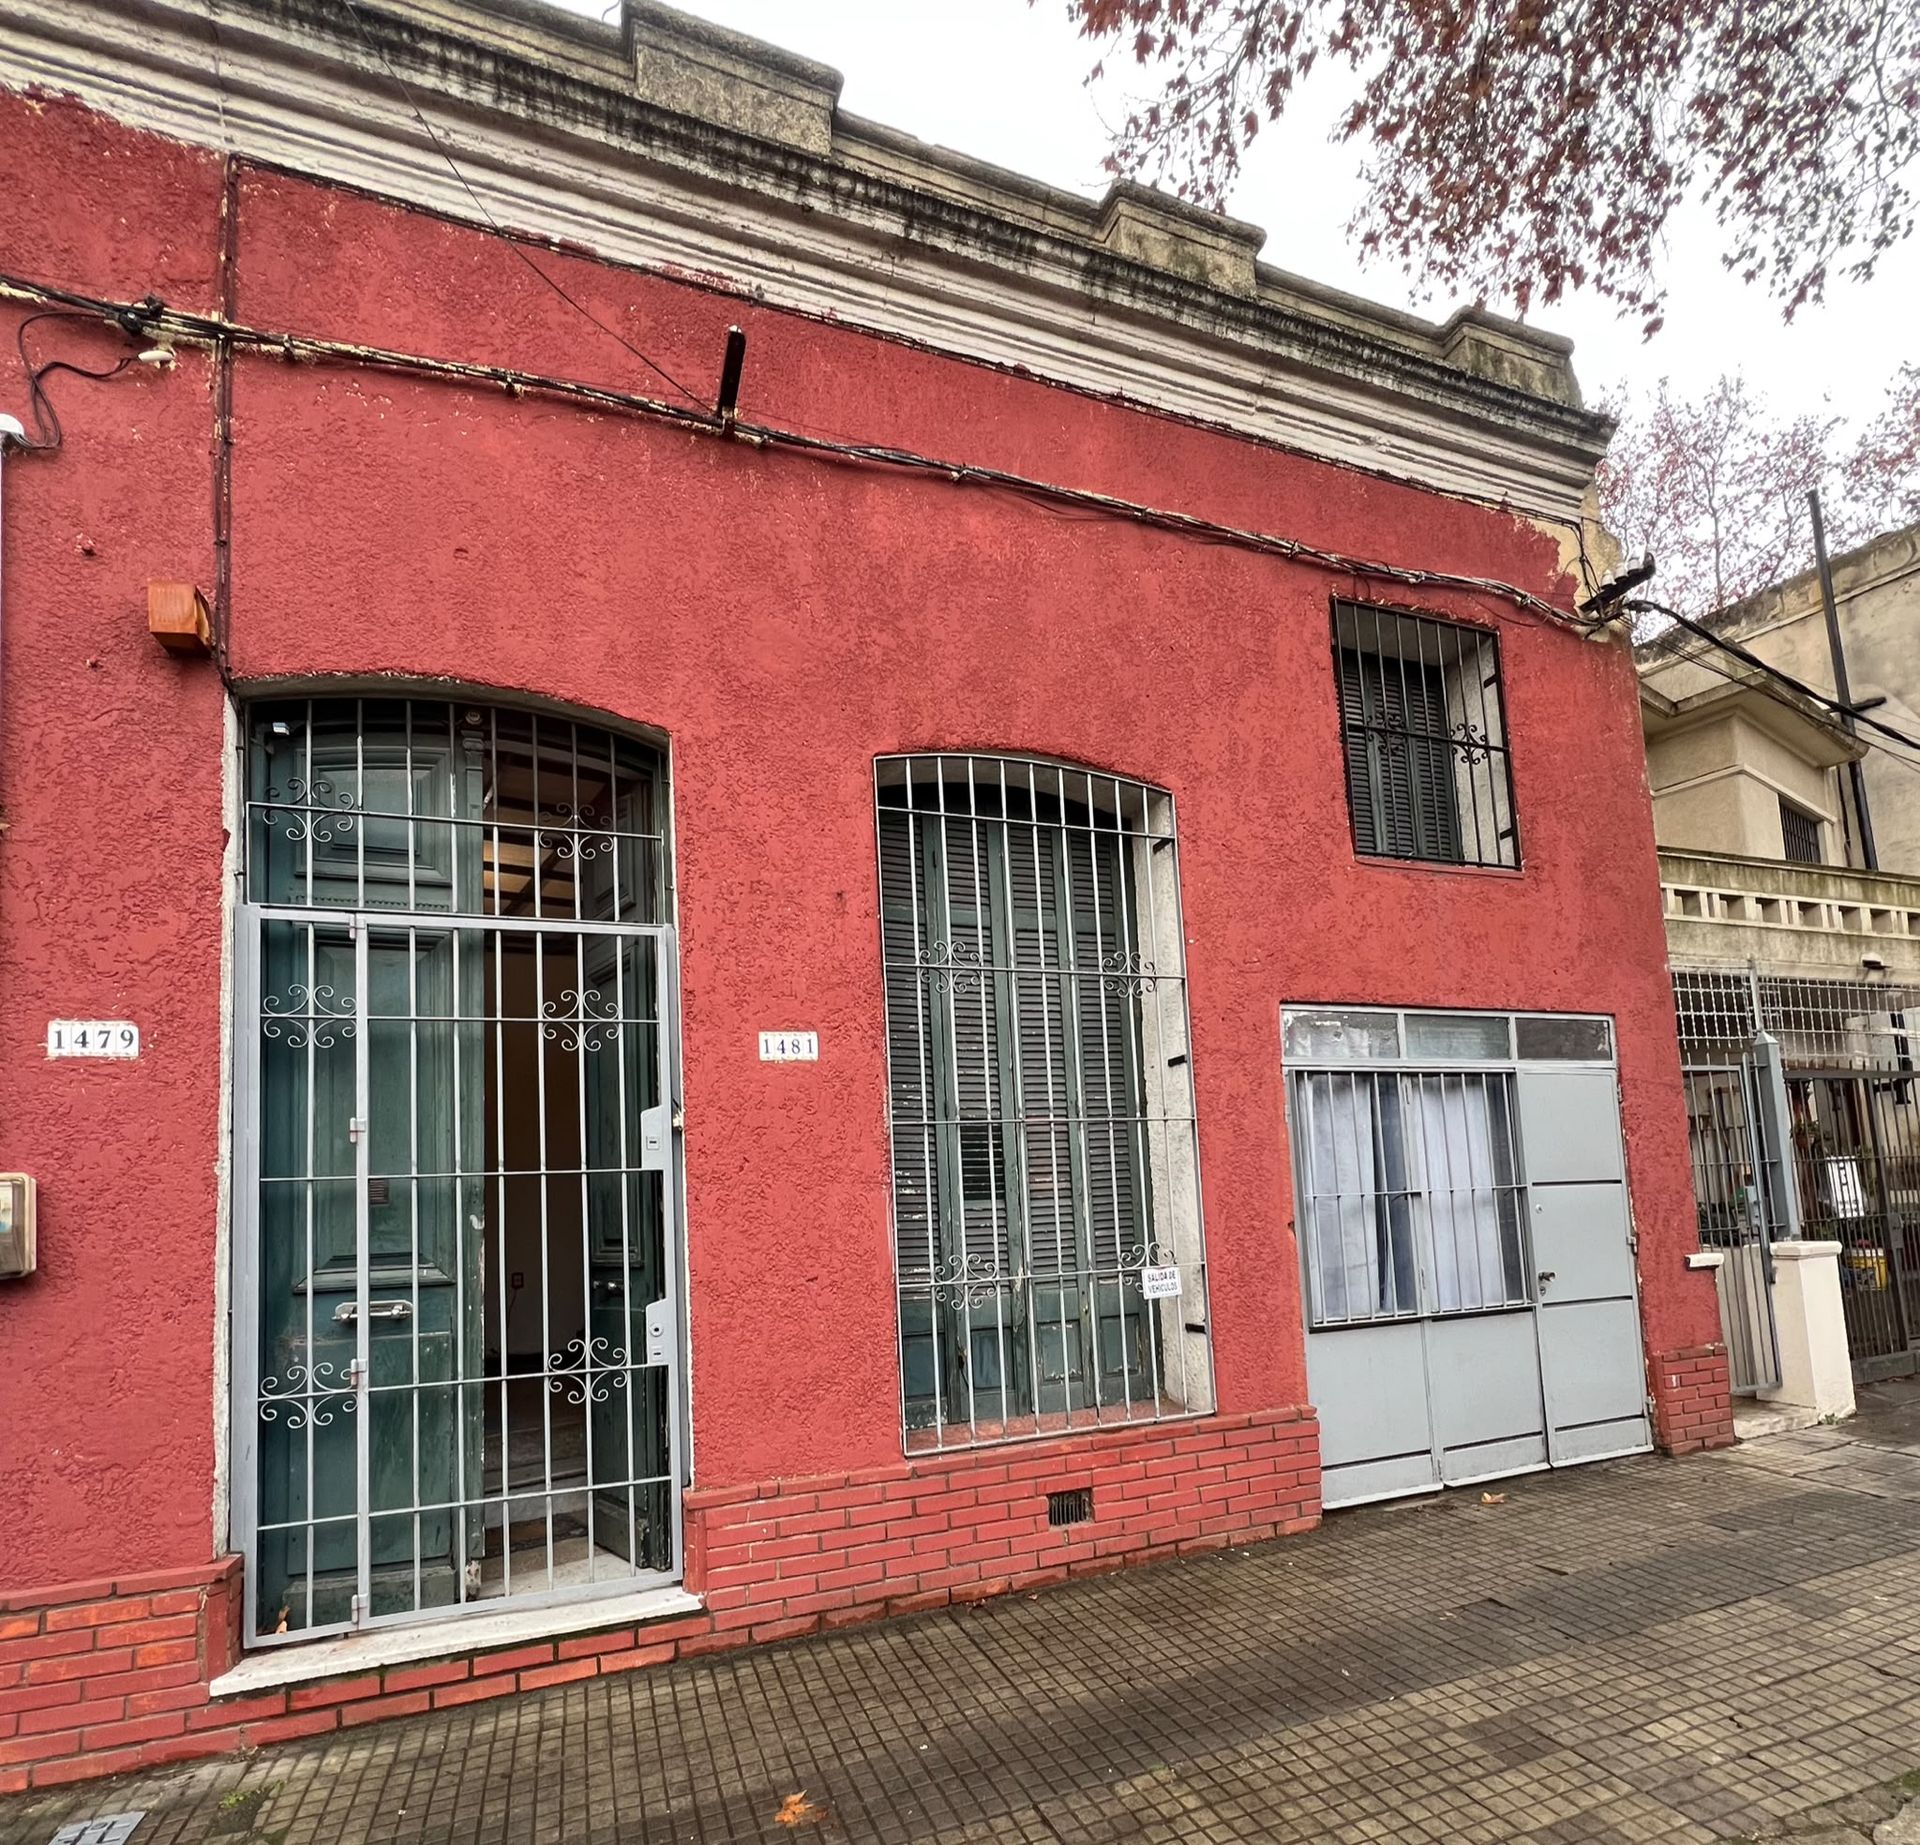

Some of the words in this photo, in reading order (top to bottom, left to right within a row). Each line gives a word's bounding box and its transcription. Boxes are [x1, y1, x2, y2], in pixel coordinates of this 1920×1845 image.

[54, 1029, 134, 1050] 1479
[764, 1038, 814, 1054] 1481
[1147, 1271, 1168, 1283] SALIDA
[1168, 1270, 1176, 1280] DE
